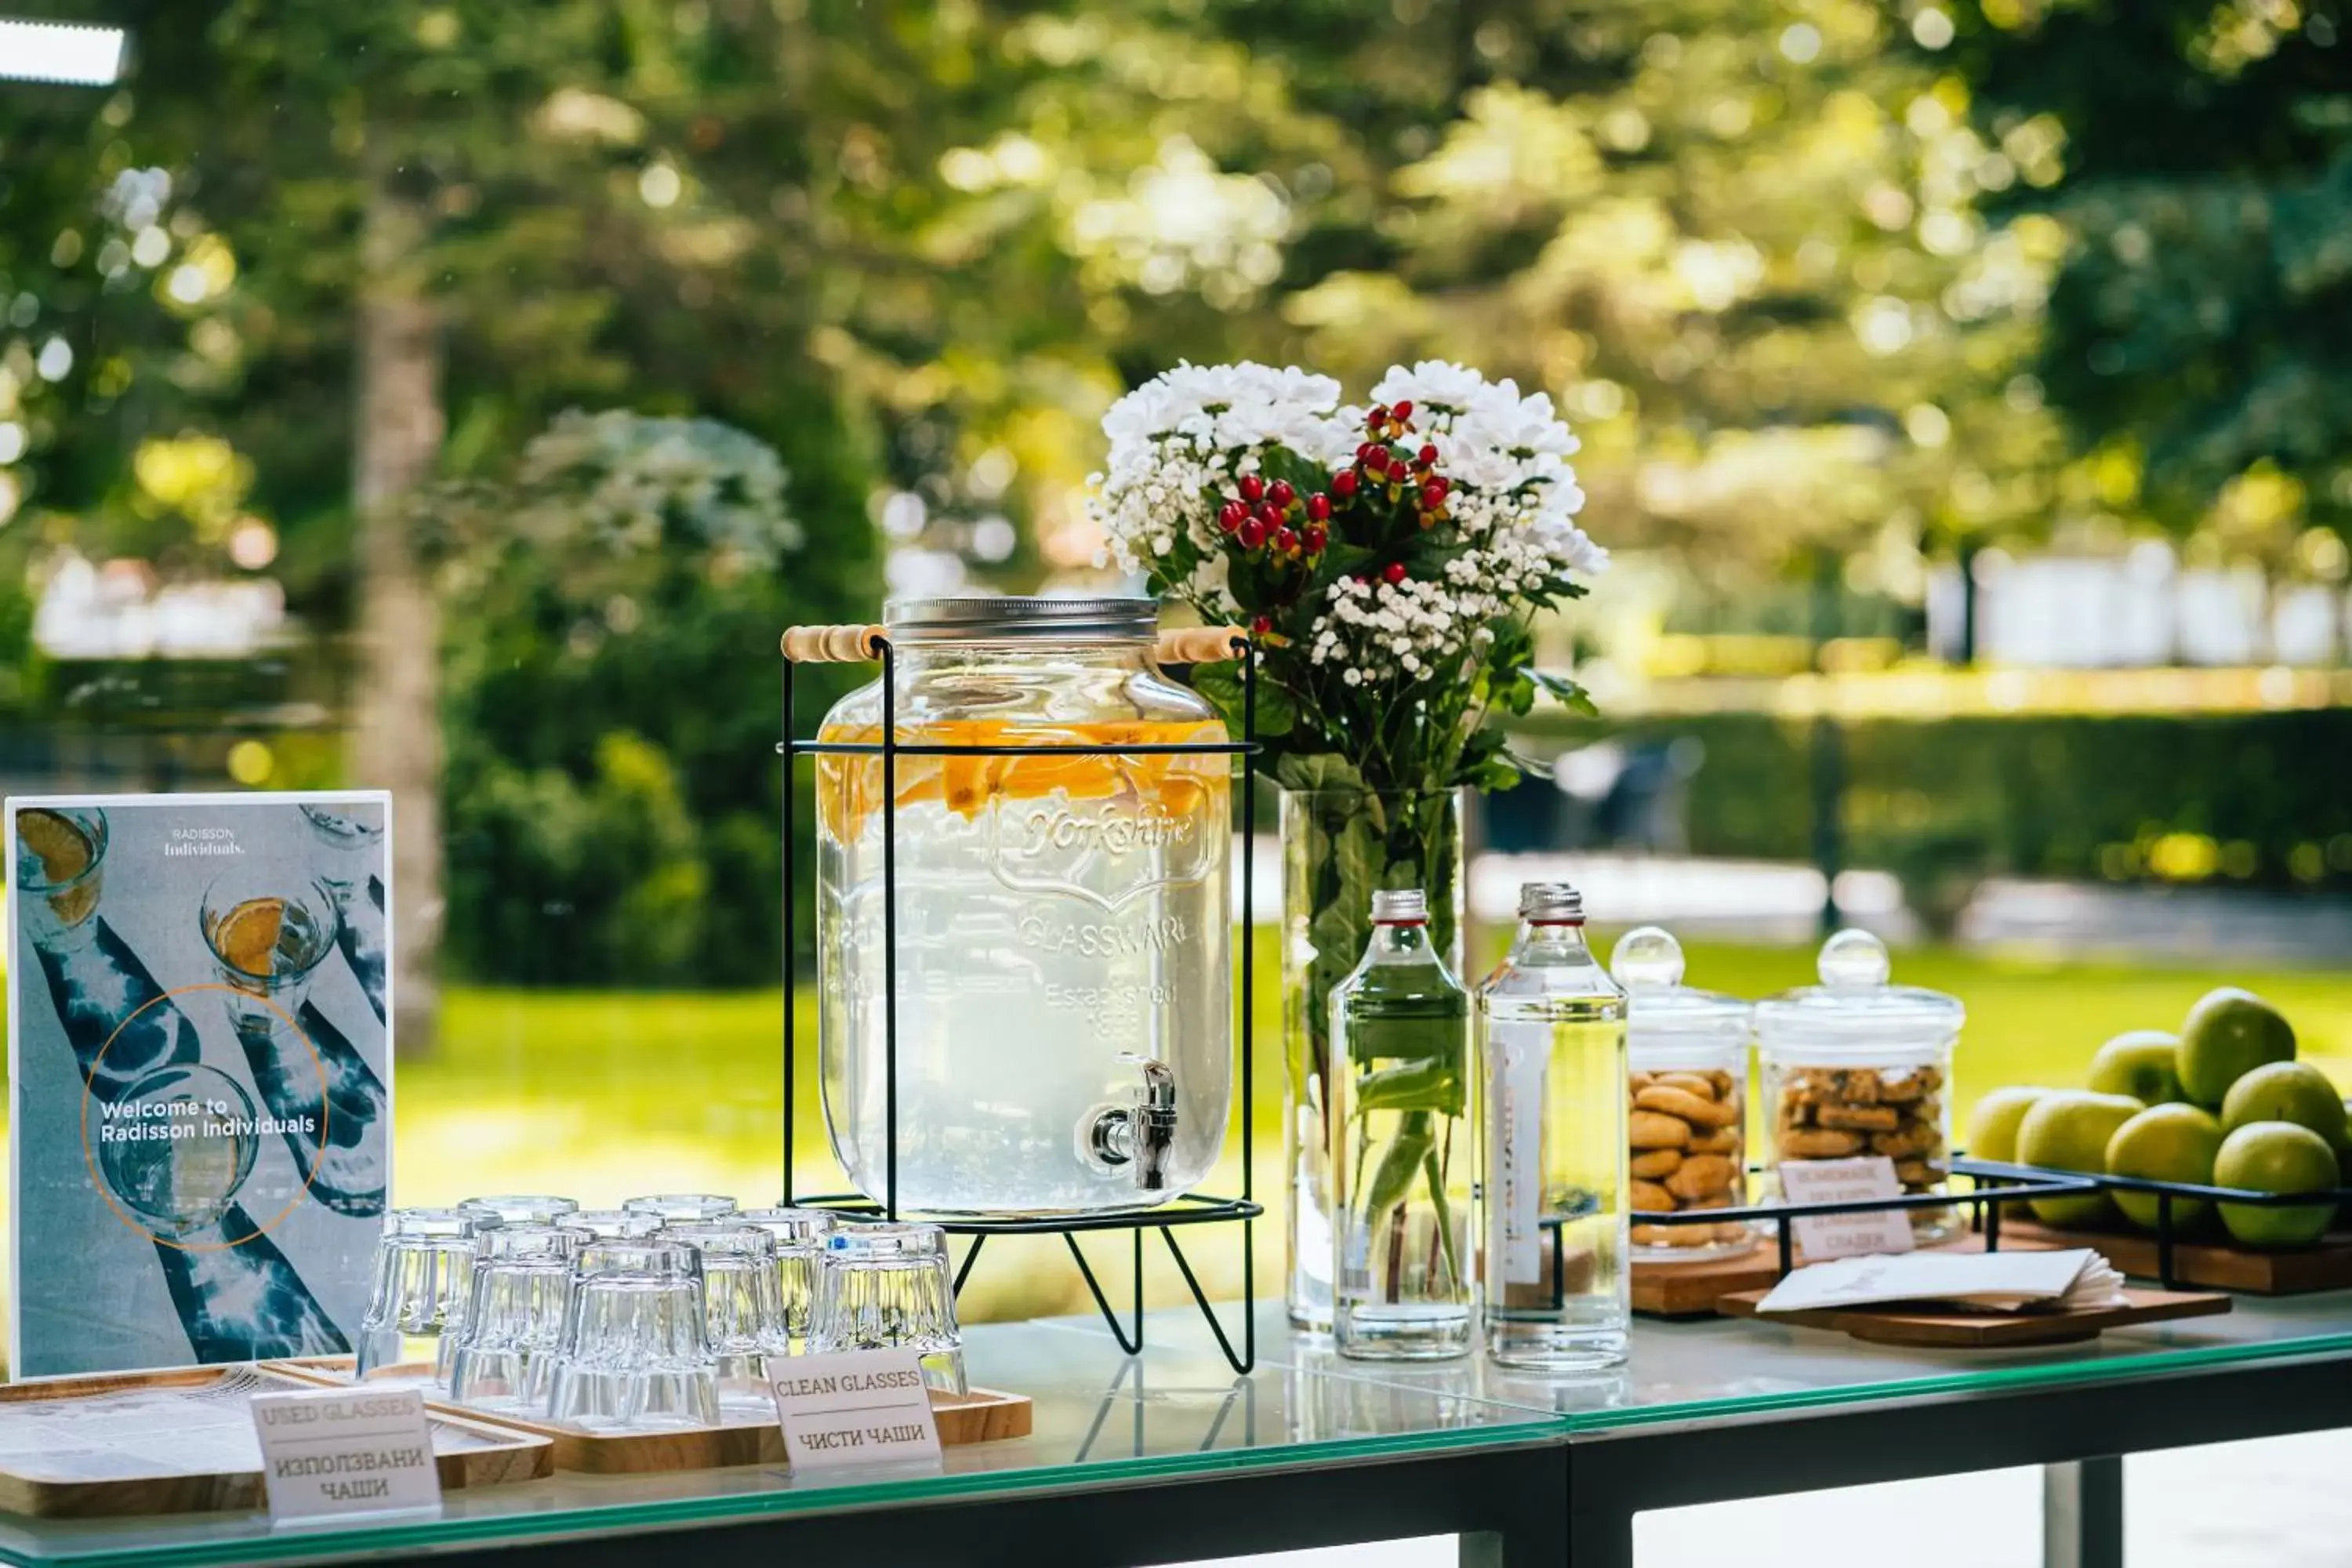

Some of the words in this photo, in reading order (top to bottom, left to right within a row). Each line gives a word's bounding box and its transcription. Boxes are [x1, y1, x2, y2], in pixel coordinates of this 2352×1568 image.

[172, 827, 234, 840] RADISSON
[100, 1099, 198, 1120] Welcome
[207, 1098, 228, 1115] to
[101, 1123, 194, 1142] Radisson
[202, 1115, 315, 1138] Individuals
[776, 1377, 837, 1398] CLEAN
[841, 1370, 920, 1392] GLASSES
[261, 1405, 319, 1425] USED
[323, 1398, 416, 1420] GLASSES
[798, 1428, 863, 1450] ЧИСТИ
[867, 1425, 925, 1444] ЧАШИ
[320, 1479, 389, 1501] ЧАШИ
